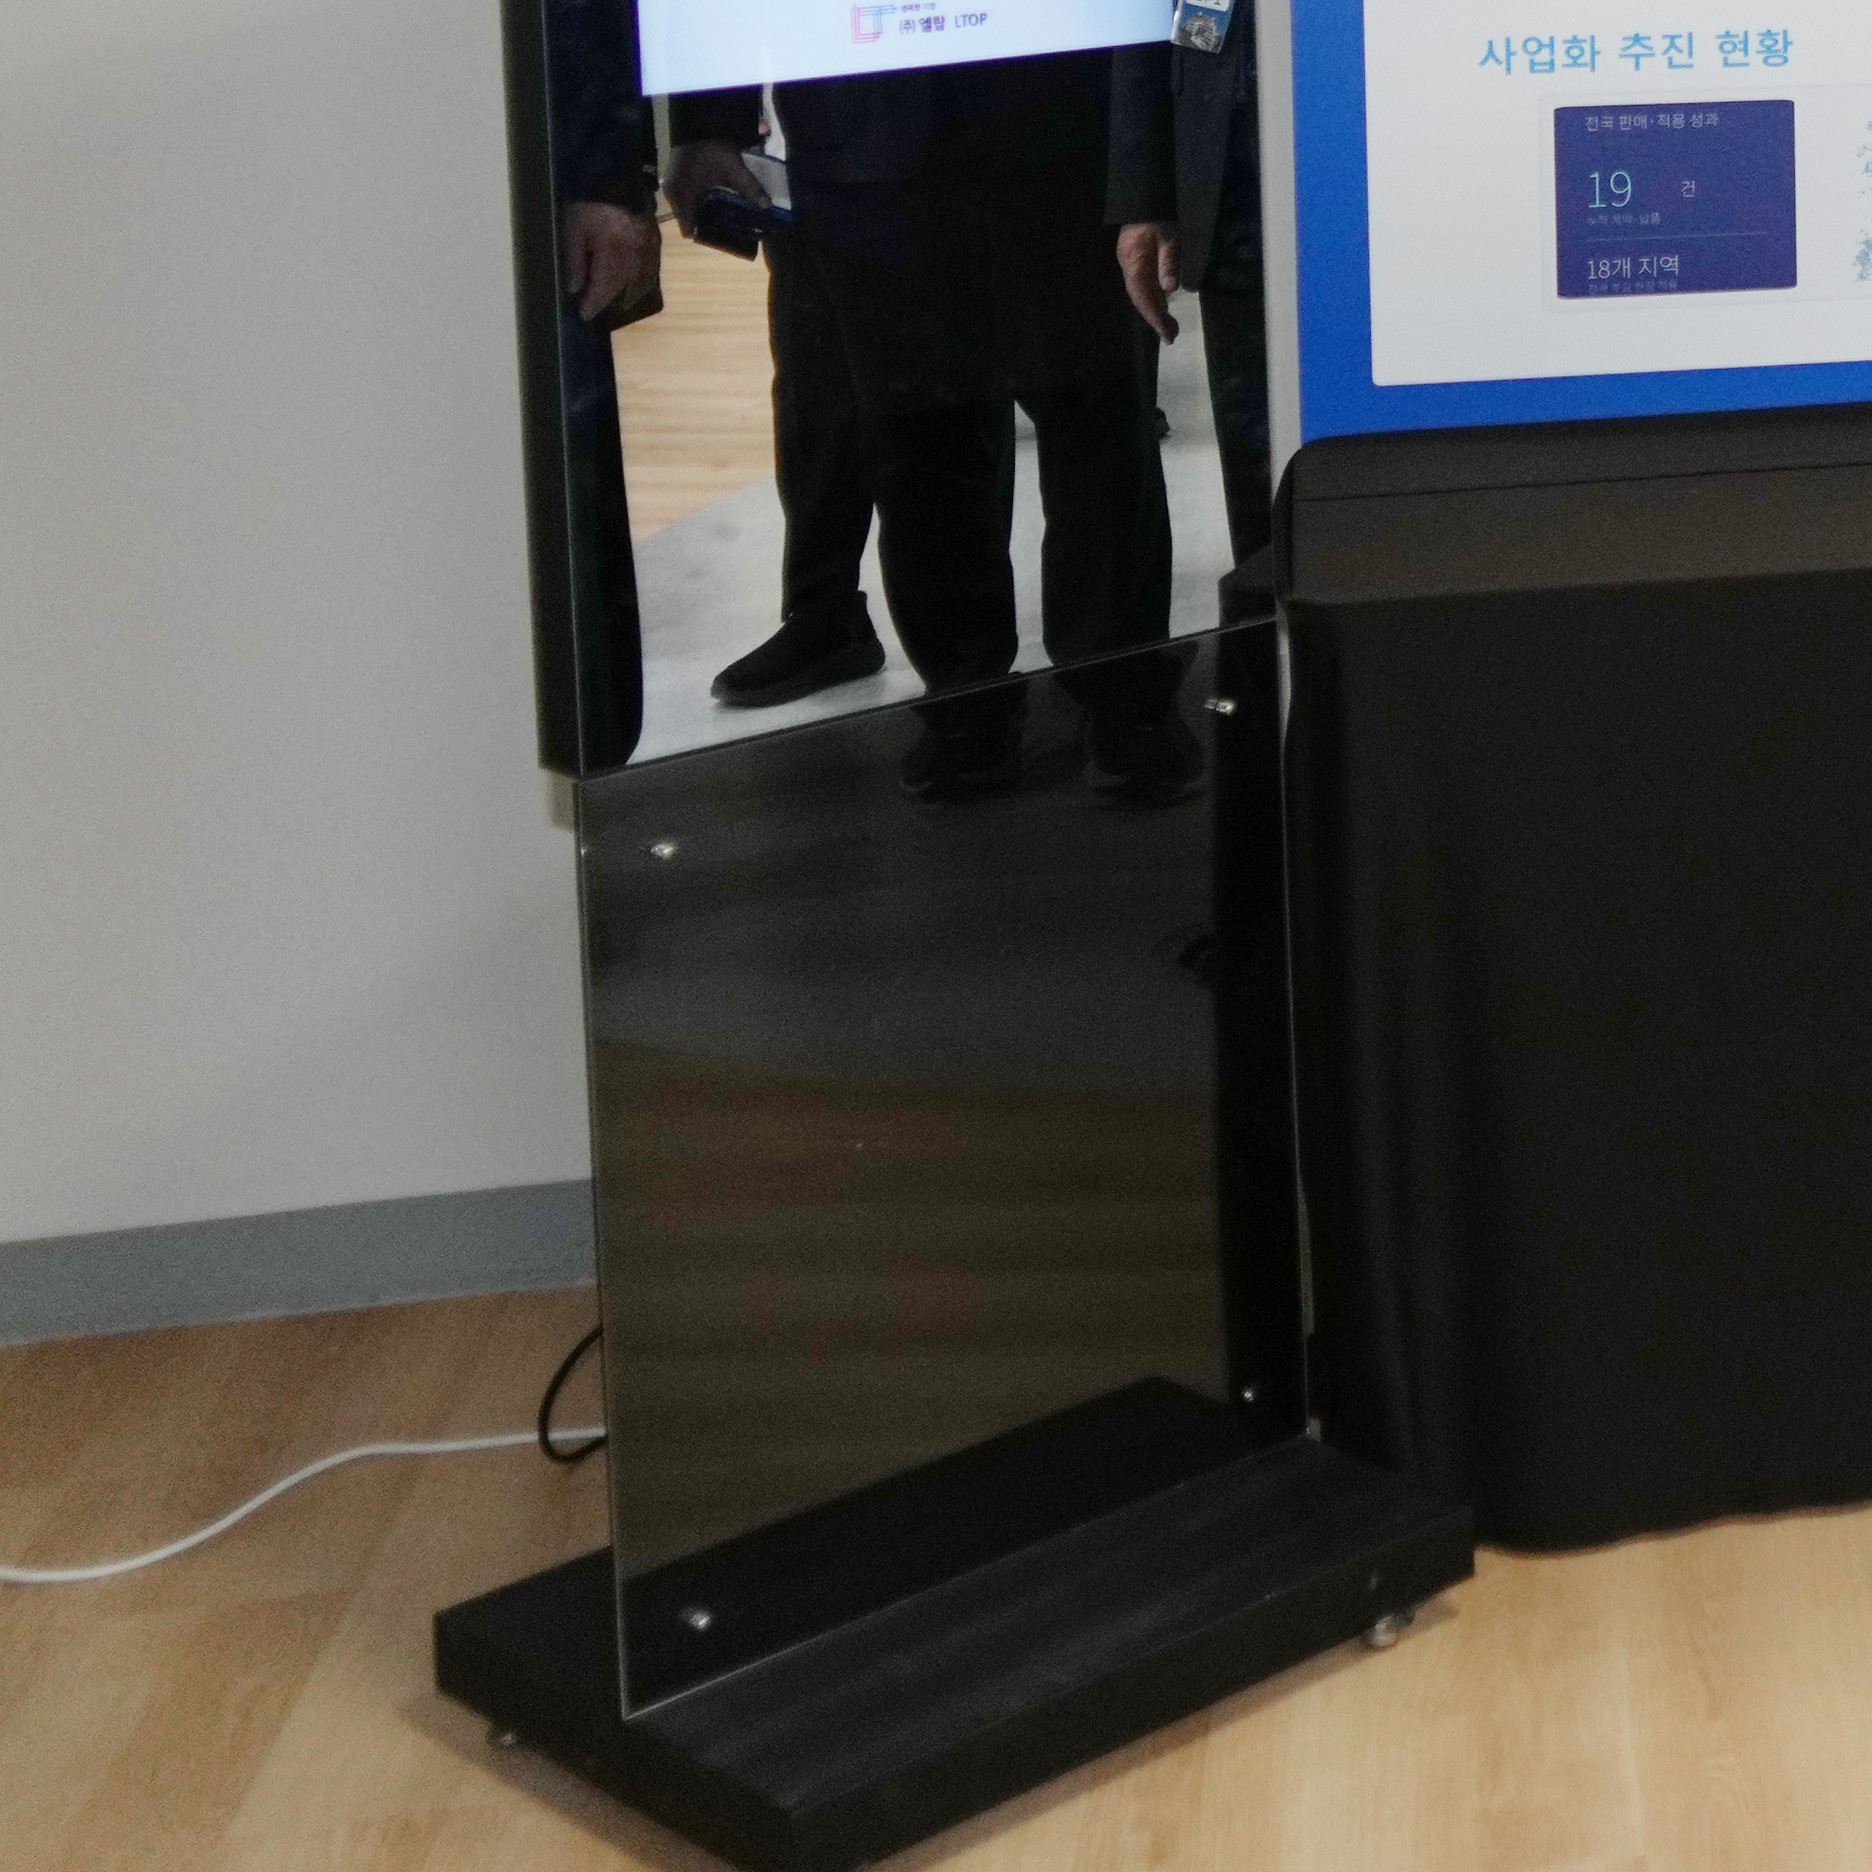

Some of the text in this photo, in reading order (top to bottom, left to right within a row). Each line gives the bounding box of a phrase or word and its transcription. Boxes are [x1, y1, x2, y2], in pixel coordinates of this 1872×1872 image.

[955, 13, 987, 29] LTOP
[1478, 28, 1794, 76] 사업화 추진 현황
[1588, 171, 1633, 209] 19
[1681, 180, 1696, 198] 건
[1587, 255, 1679, 280] 18개 지역
